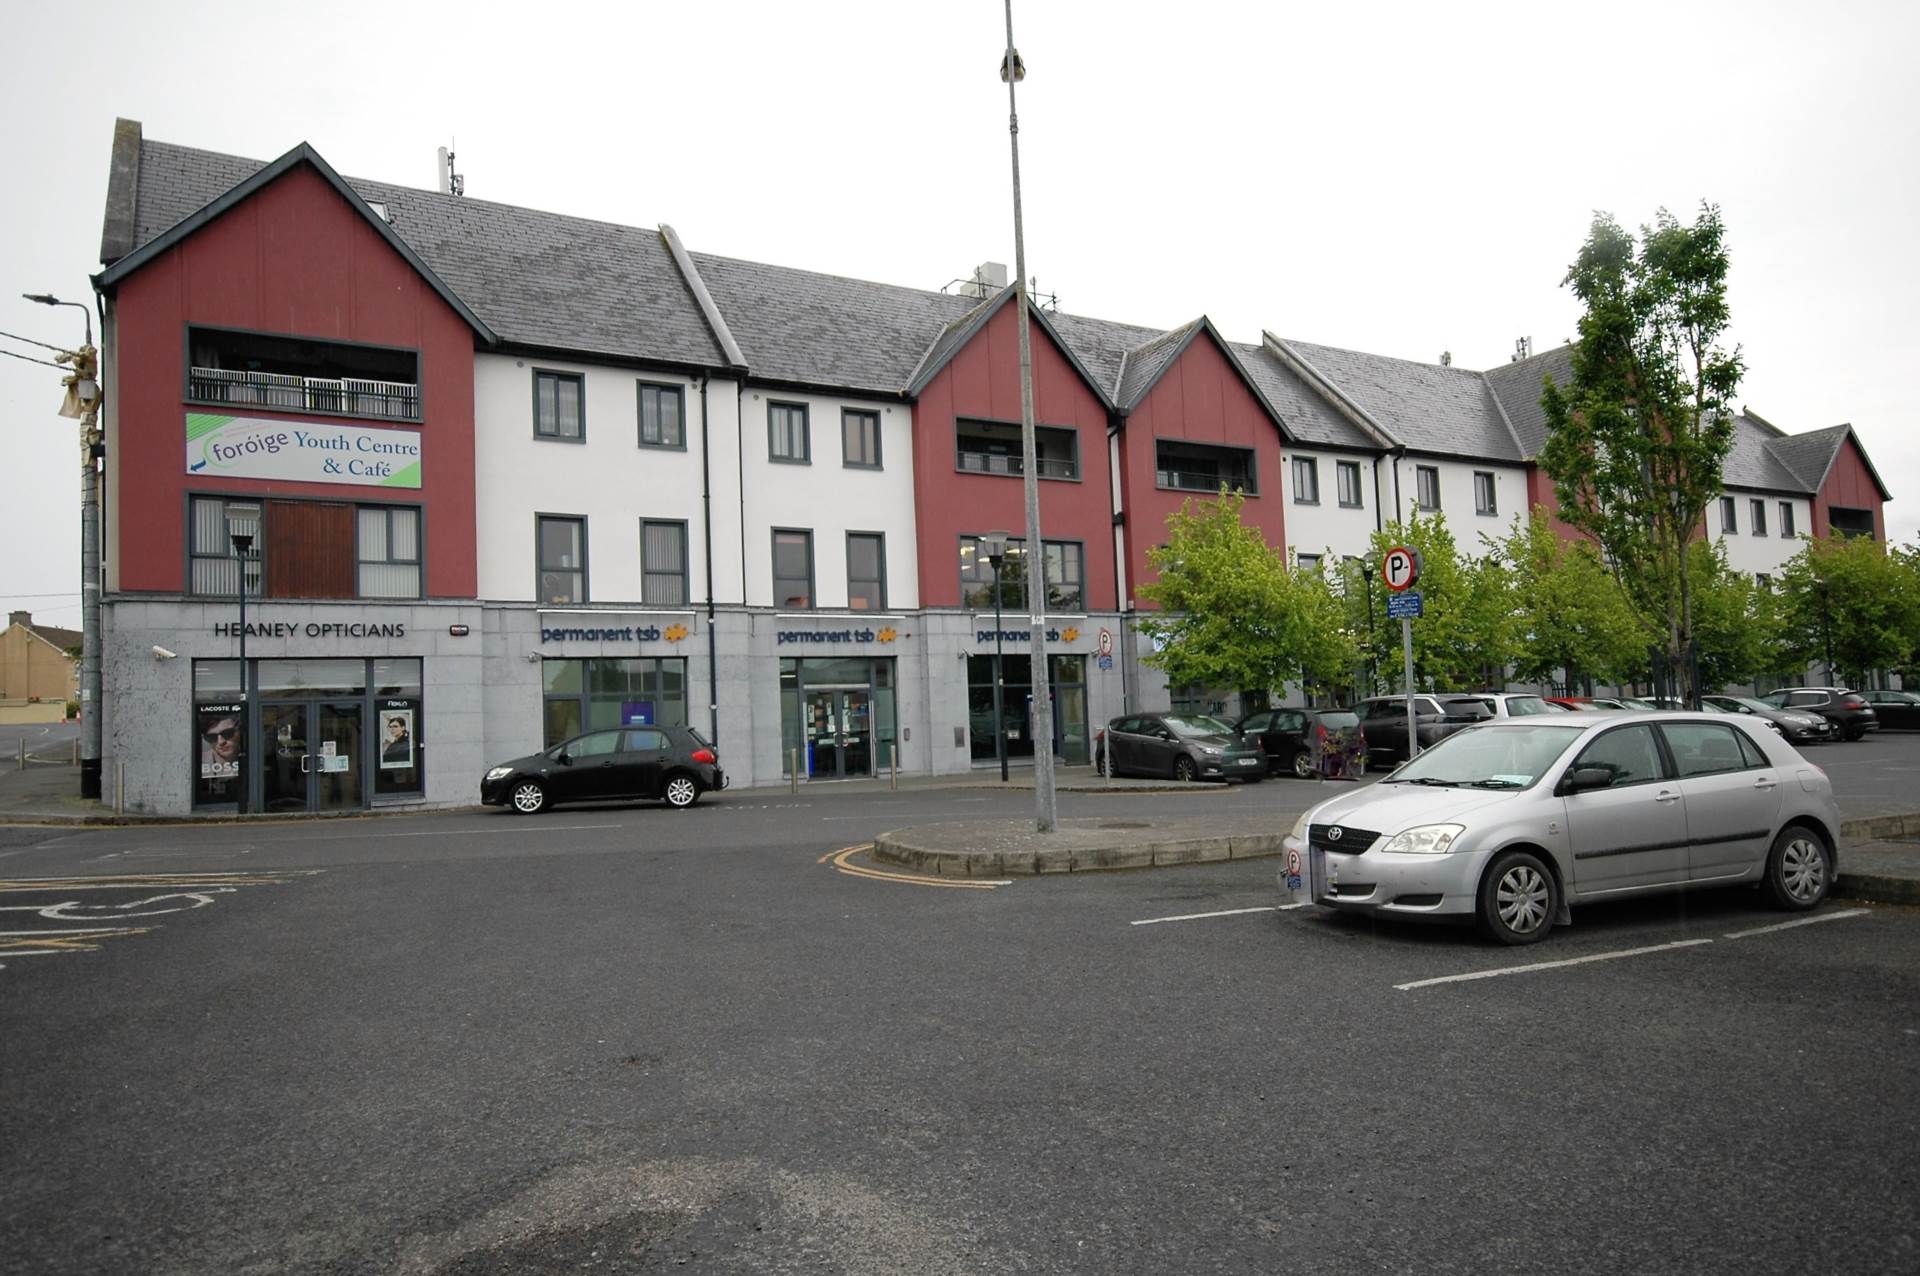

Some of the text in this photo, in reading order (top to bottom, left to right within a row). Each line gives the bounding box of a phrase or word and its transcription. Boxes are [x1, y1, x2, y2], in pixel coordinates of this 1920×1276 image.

[213, 430, 418, 461] foróige Youth Centre
[322, 457, 391, 477] & Café
[1391, 556, 1403, 582] P
[215, 623, 405, 638] HEANEY OPTICIANS
[541, 625, 660, 644] permanent tsb
[777, 627, 875, 645] permanent tsb
[977, 627, 1060, 644] permane sb
[201, 761, 240, 774] BOSS
